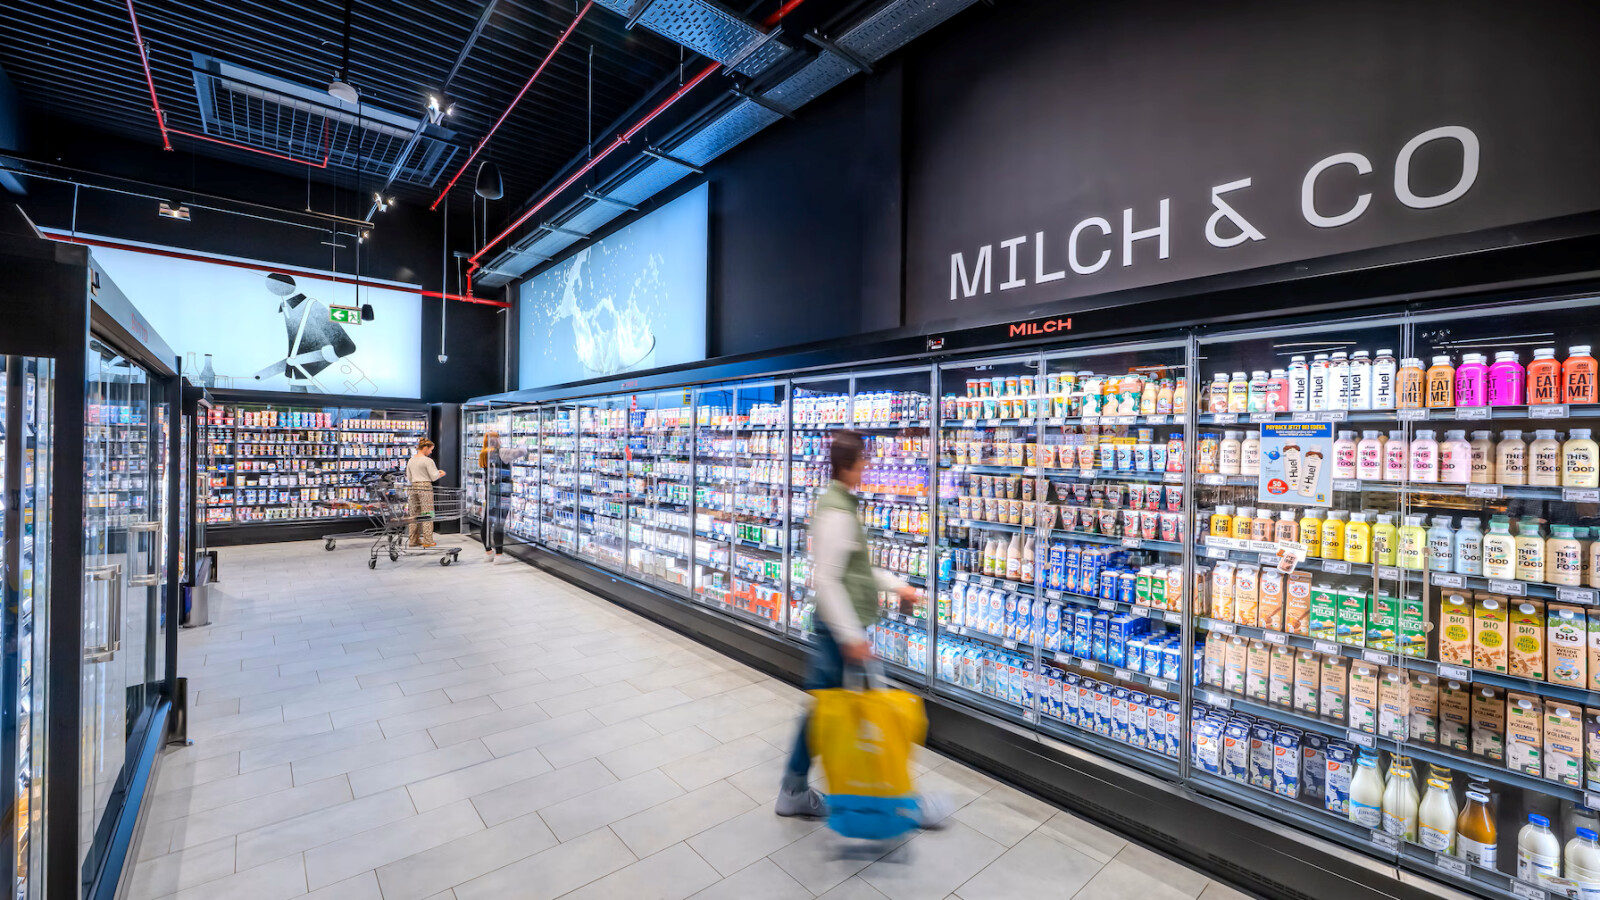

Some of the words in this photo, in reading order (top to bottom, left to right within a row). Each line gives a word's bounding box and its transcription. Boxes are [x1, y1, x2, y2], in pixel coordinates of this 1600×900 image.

[950, 198, 1170, 300] MILCH
[1204, 177, 1266, 248] &
[1301, 125, 1480, 228] CO
[1009, 318, 1072, 338] MILCH
[1378, 372, 1390, 396] Huel
[1456, 378, 1474, 390] EAT
[1488, 378, 1497, 390] AT
[1536, 373, 1558, 387] EAT
[1569, 373, 1595, 385] EAT
[1294, 377, 1306, 399] Huel
[1314, 375, 1324, 398] Huel
[1350, 374, 1361, 397] Huel
[1430, 380, 1450, 391] EAT
[1568, 385, 1594, 398] ME!
[1430, 391, 1450, 402] ME!
[1456, 390, 1474, 401] ME!
[1489, 390, 1497, 400] E!
[1535, 387, 1559, 399] ME!
[1288, 458, 1298, 478] Huel
[1304, 464, 1316, 484] Huel
[1312, 608, 1334, 616] MILCH
[1340, 612, 1362, 621] MILCH
[1450, 616, 1464, 624] BIO
[1483, 621, 1499, 630] BIO
[1519, 626, 1535, 635] BIO
[1555, 633, 1578, 641] bio
[1510, 722, 1540, 732] VOLLMILCH
[1546, 730, 1580, 741] VOLLMILCH
